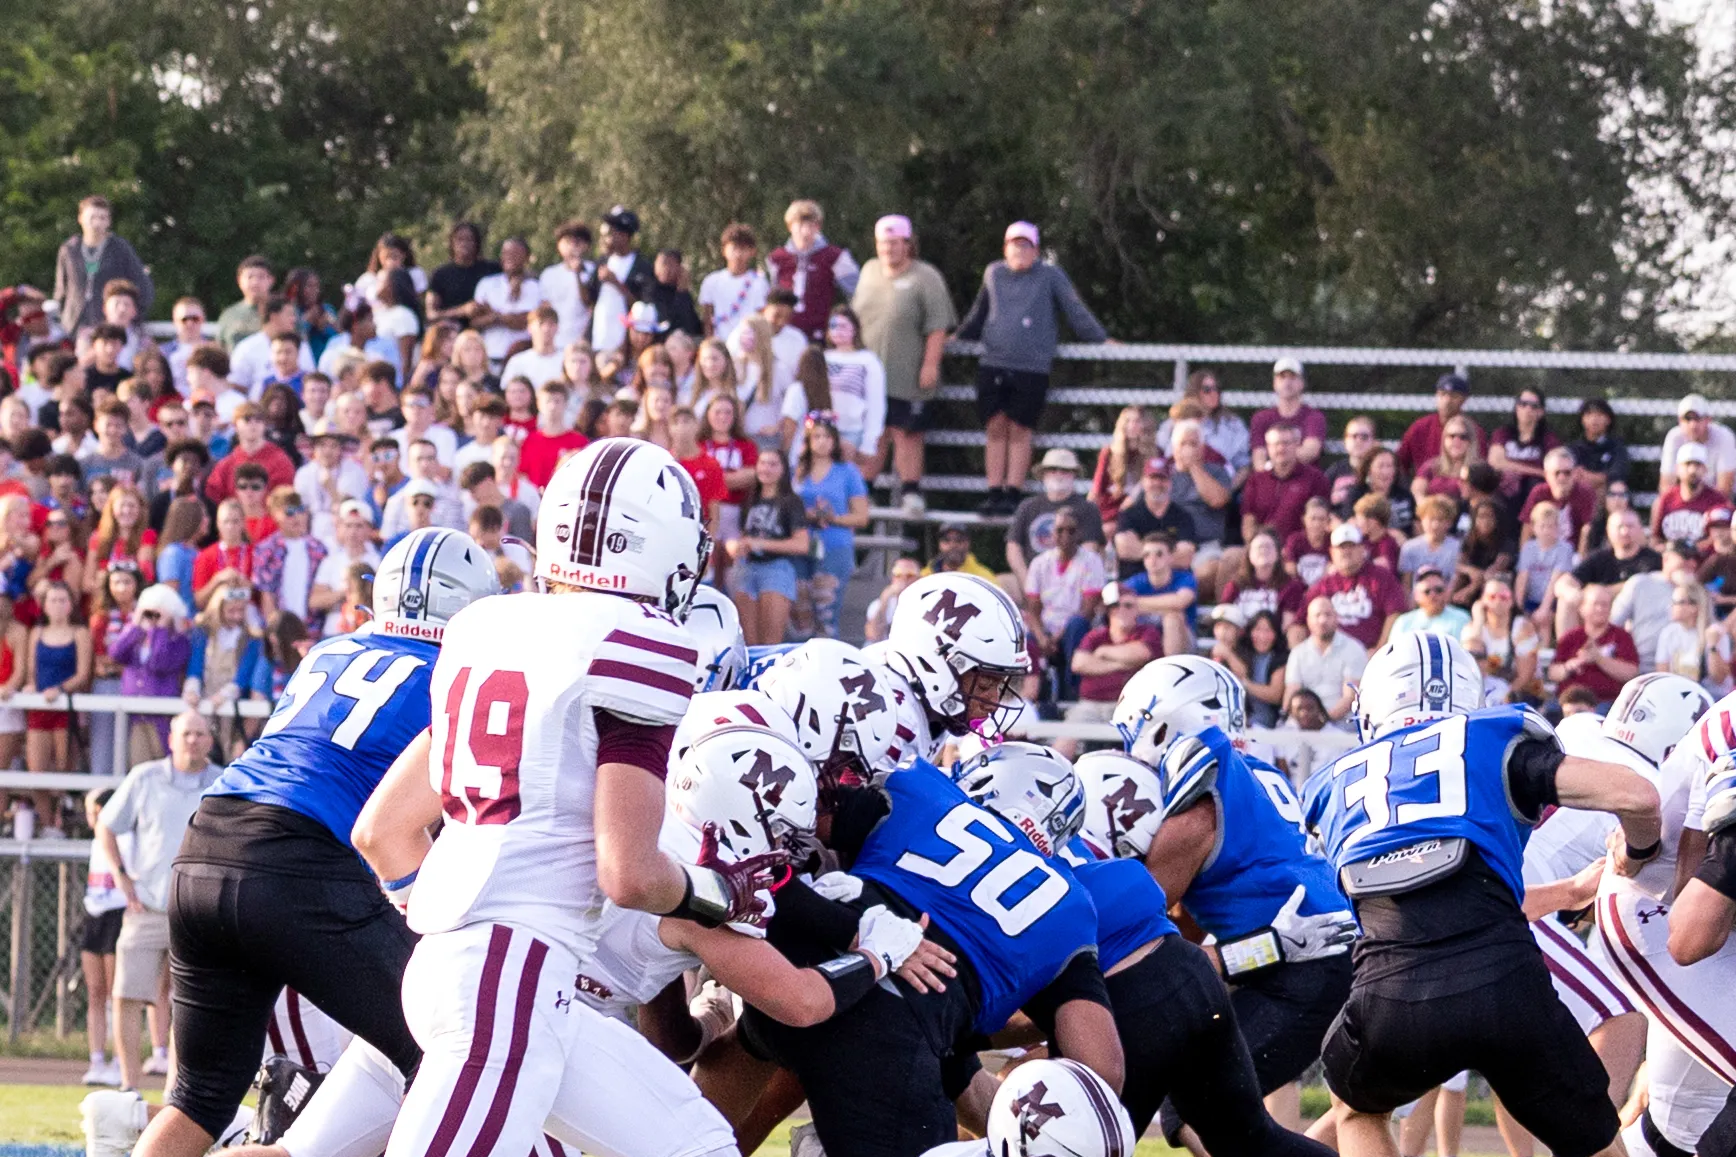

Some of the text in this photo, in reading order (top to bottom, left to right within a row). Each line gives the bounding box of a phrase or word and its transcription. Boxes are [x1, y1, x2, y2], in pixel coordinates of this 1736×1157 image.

[609, 534, 625, 552] 19
[551, 563, 627, 589] Riddell
[385, 621, 444, 640] Riddell
[922, 588, 981, 642] M
[839, 668, 887, 722] M
[441, 666, 529, 826] 19
[738, 748, 796, 808] M
[1101, 777, 1157, 832] M
[1332, 714, 1468, 851] 33
[895, 801, 1070, 937] 50
[283, 1071, 311, 1112] NIKE
[1009, 1080, 1066, 1141] M
